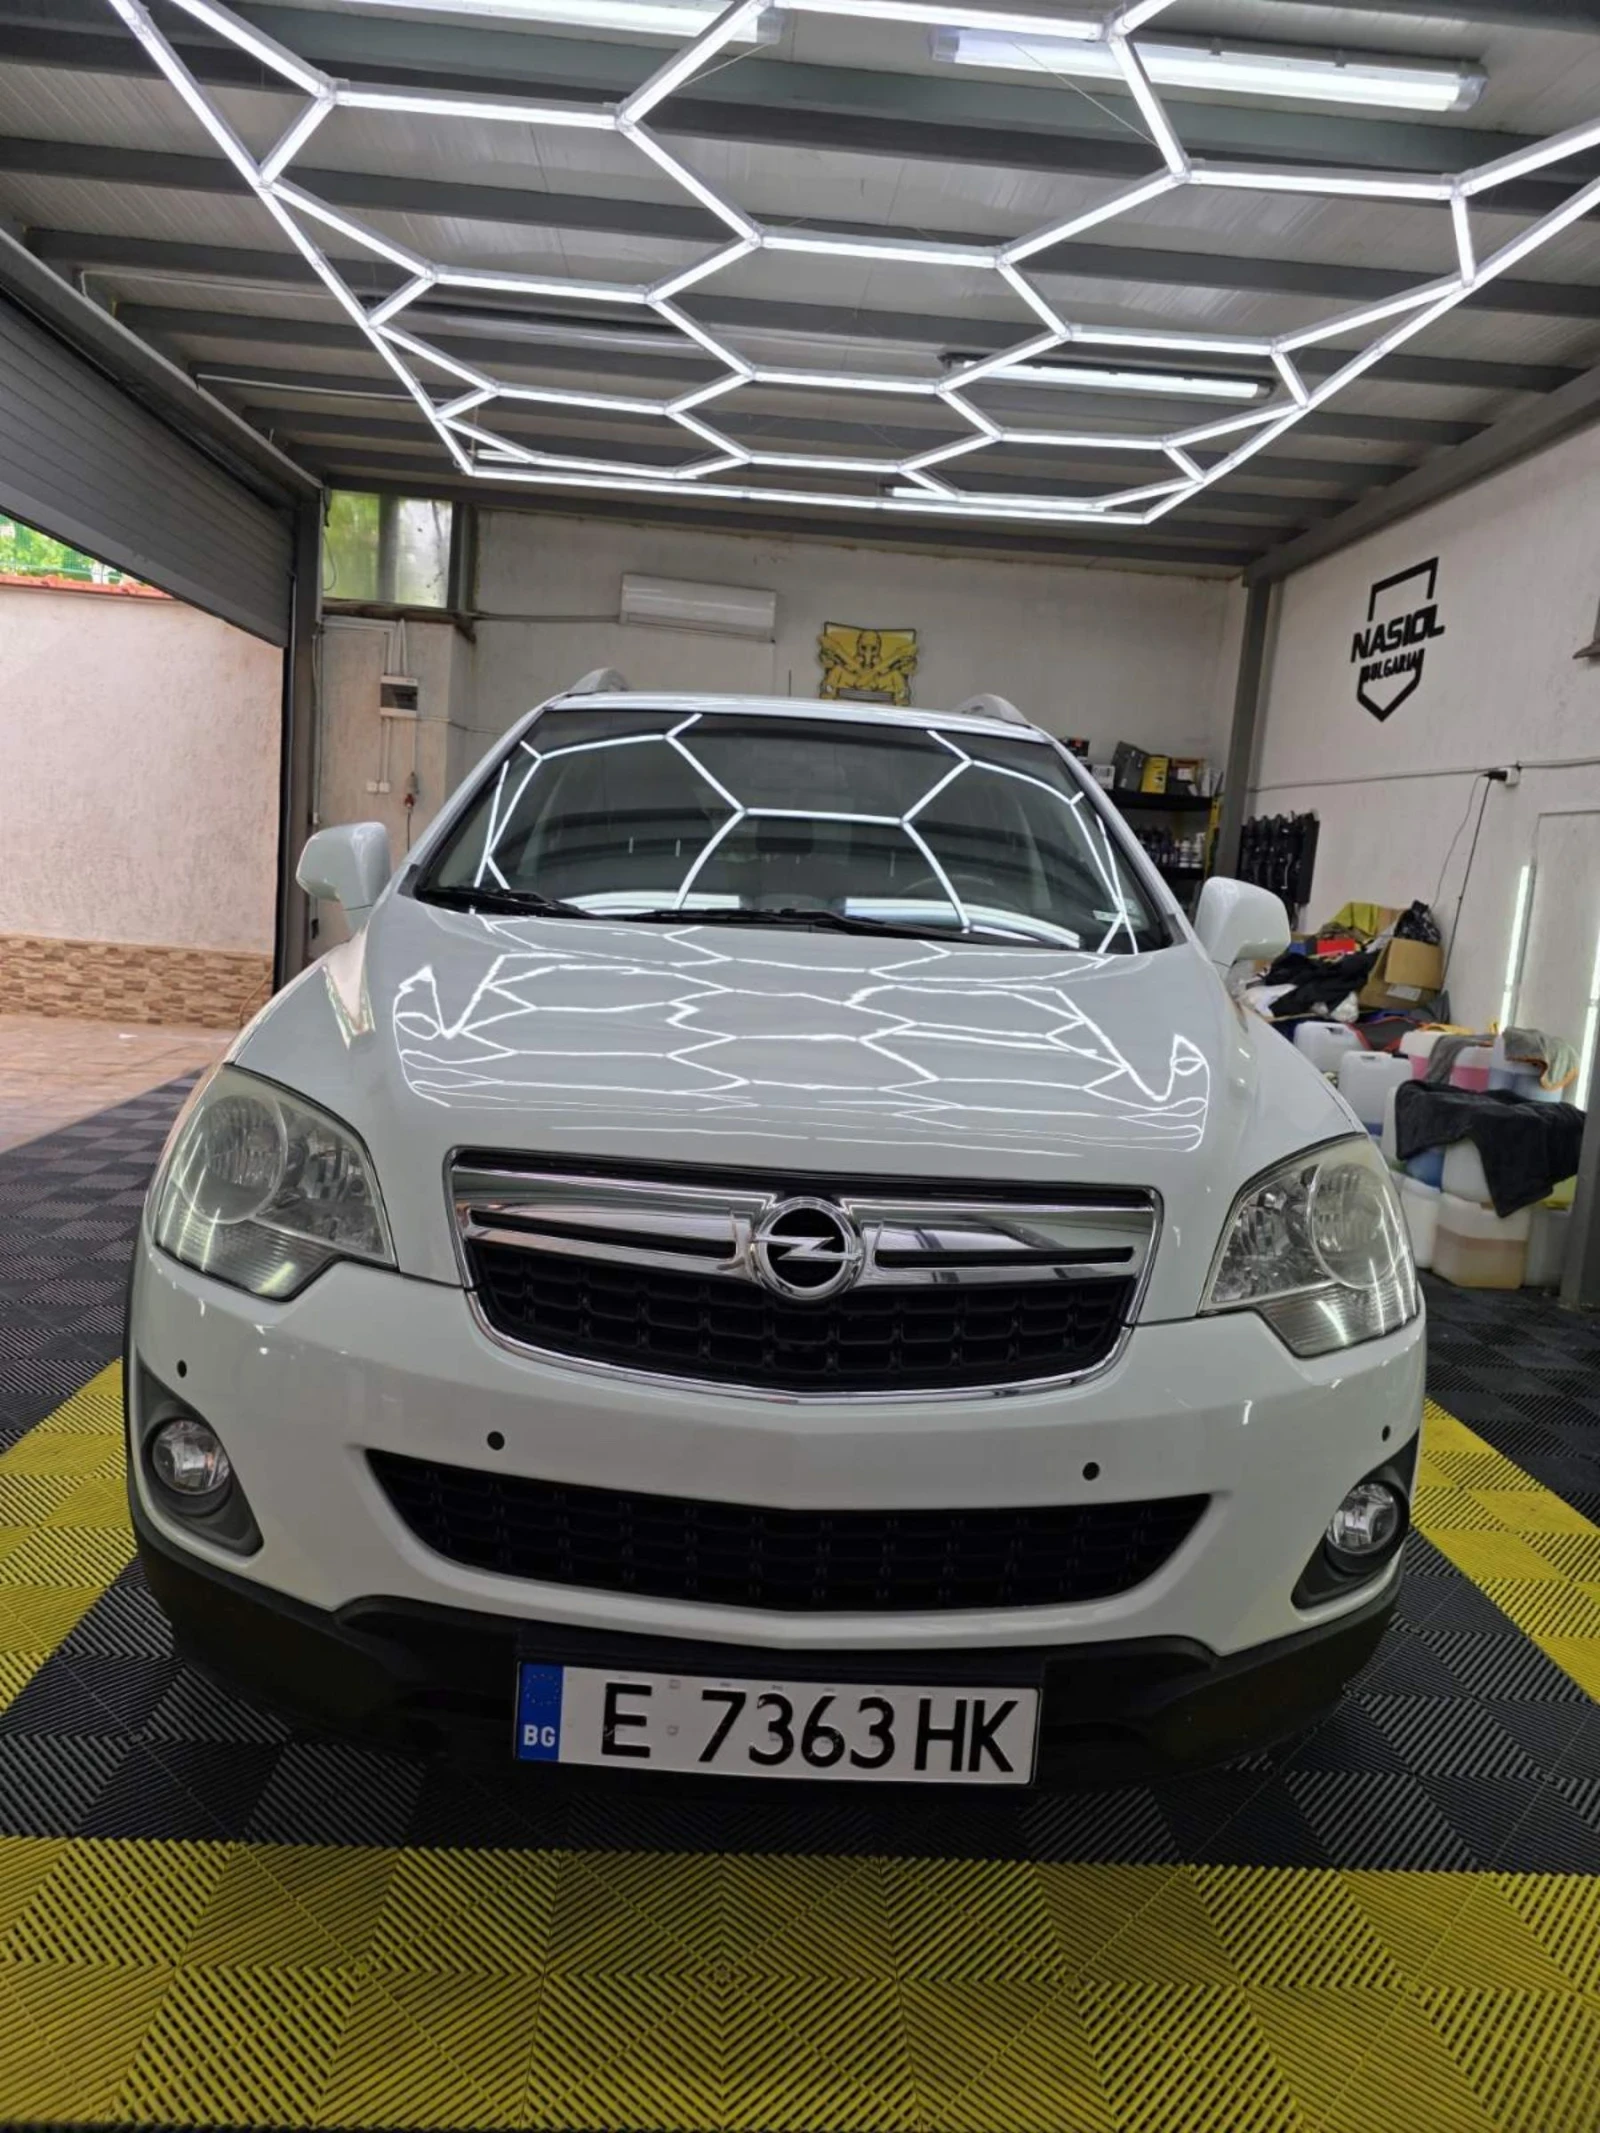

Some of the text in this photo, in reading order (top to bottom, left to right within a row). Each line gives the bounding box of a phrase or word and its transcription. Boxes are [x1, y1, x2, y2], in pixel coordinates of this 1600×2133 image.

[1351, 604, 1445, 663] NASIOL
[523, 1724, 556, 1748] BG
[601, 1682, 652, 1758] E
